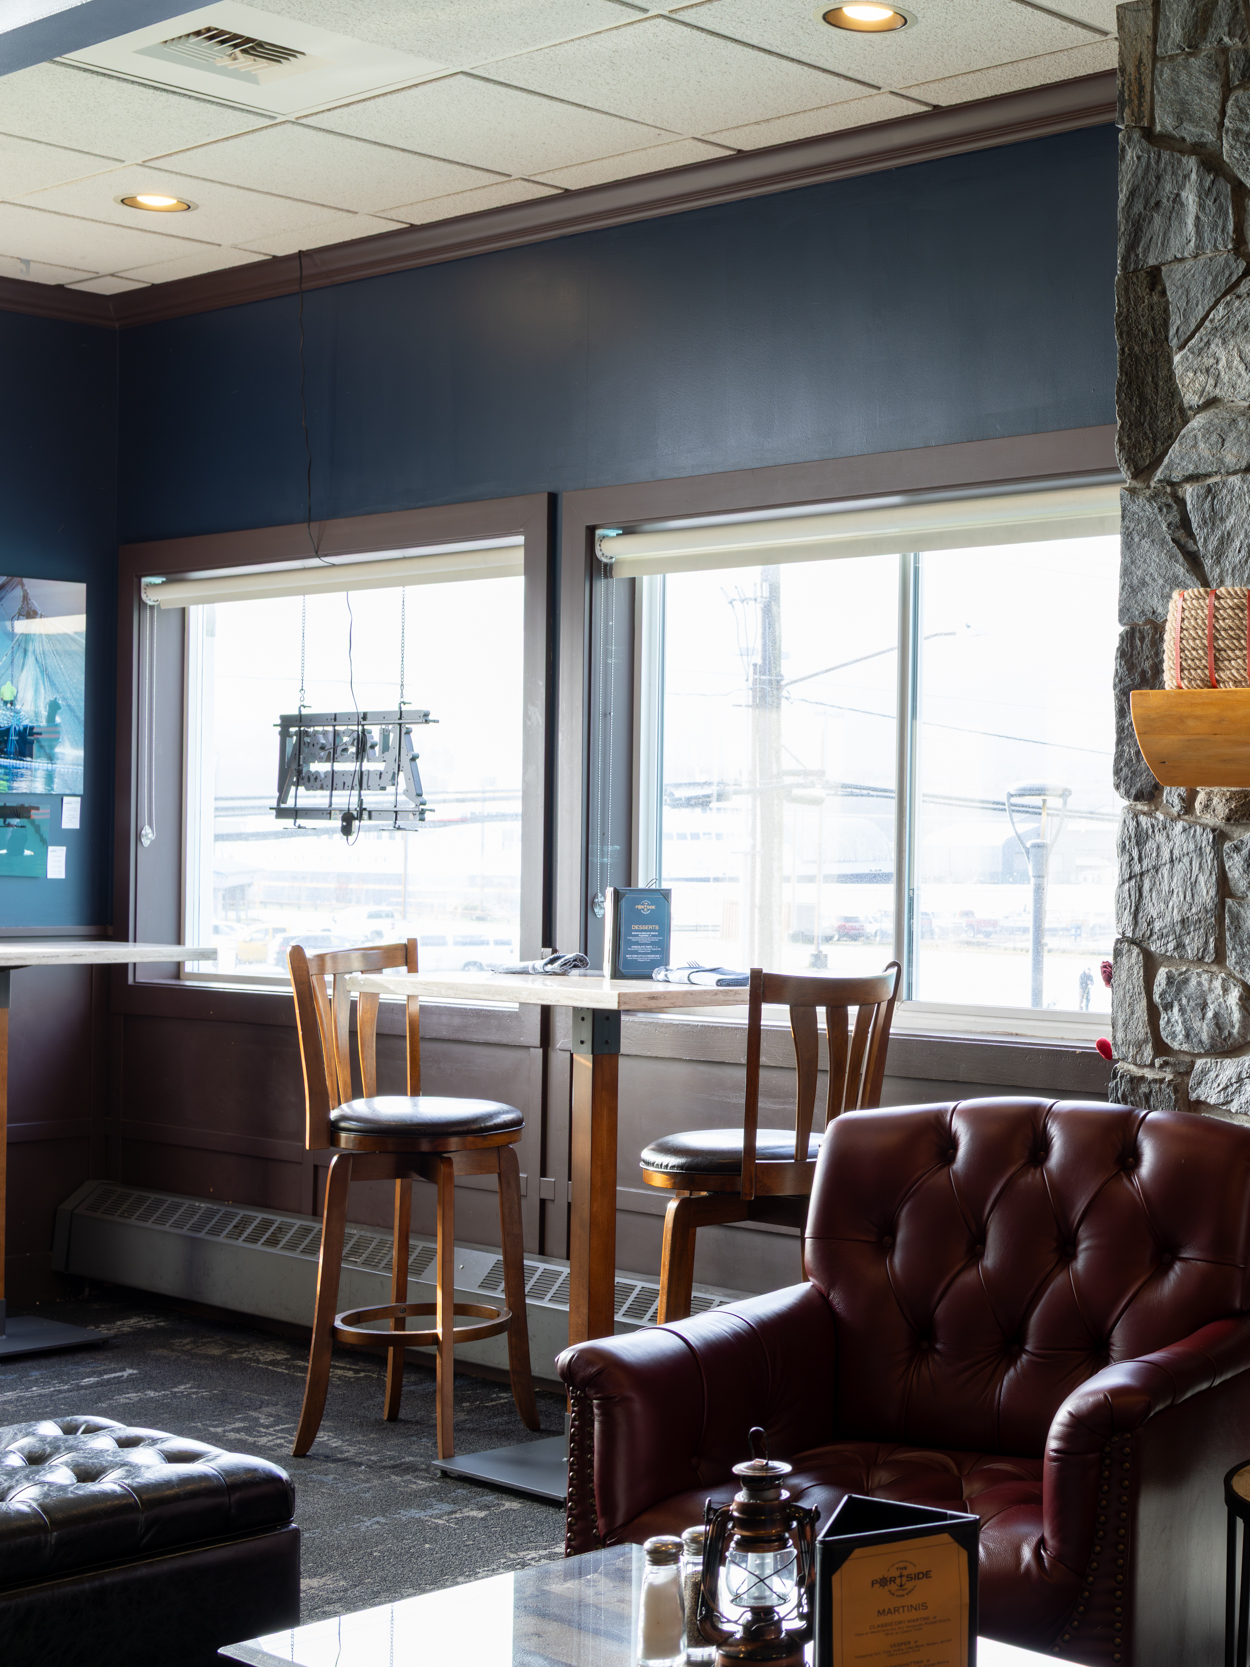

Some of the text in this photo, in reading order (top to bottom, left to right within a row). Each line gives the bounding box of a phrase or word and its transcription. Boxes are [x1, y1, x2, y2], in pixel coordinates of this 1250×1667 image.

[871, 1569, 932, 1589] PORTSIDE
[877, 1602, 929, 1617] MARTINIS
[869, 1621, 894, 1630] CLASSIC
[889, 1641, 911, 1649] VESPER
